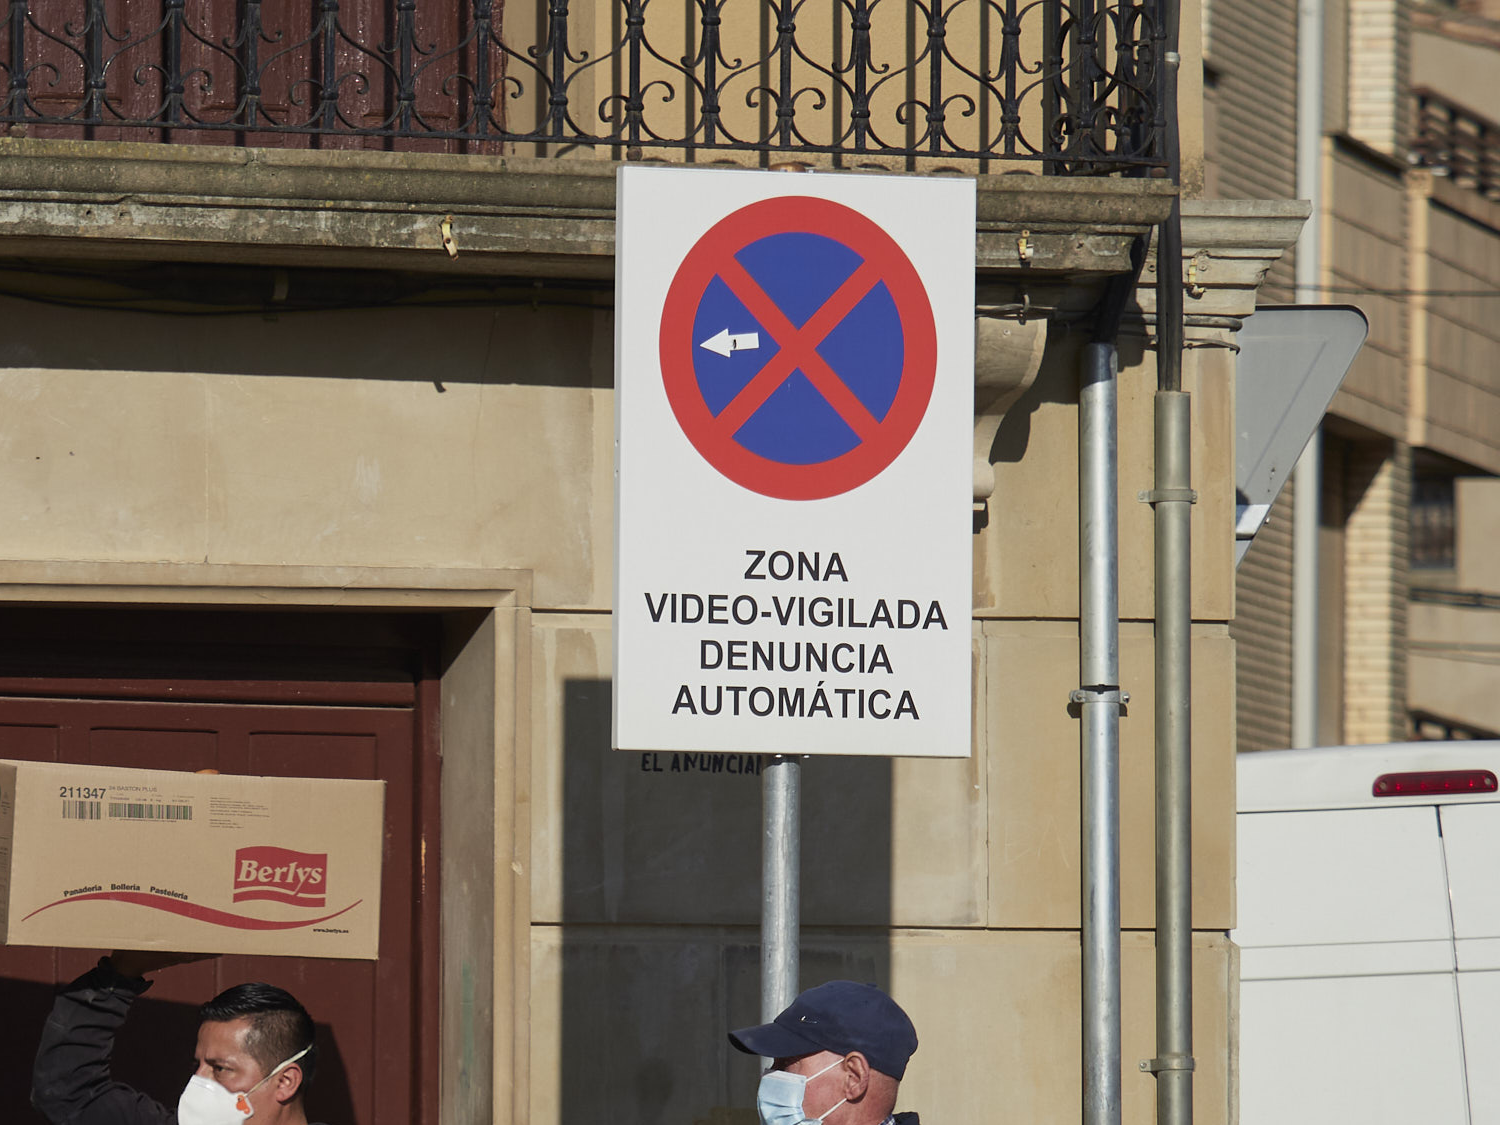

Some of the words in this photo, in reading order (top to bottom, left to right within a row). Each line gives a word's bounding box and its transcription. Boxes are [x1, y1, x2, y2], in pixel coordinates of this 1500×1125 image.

[744, 550, 849, 582] ZONA
[644, 592, 949, 630] VIDEO-VIGILADA
[700, 640, 894, 674] DENUNCIA
[671, 681, 920, 720] AUTOMÁTICA
[641, 753, 663, 772] EL
[59, 786, 106, 799] 211347
[237, 859, 323, 895] Berlys
